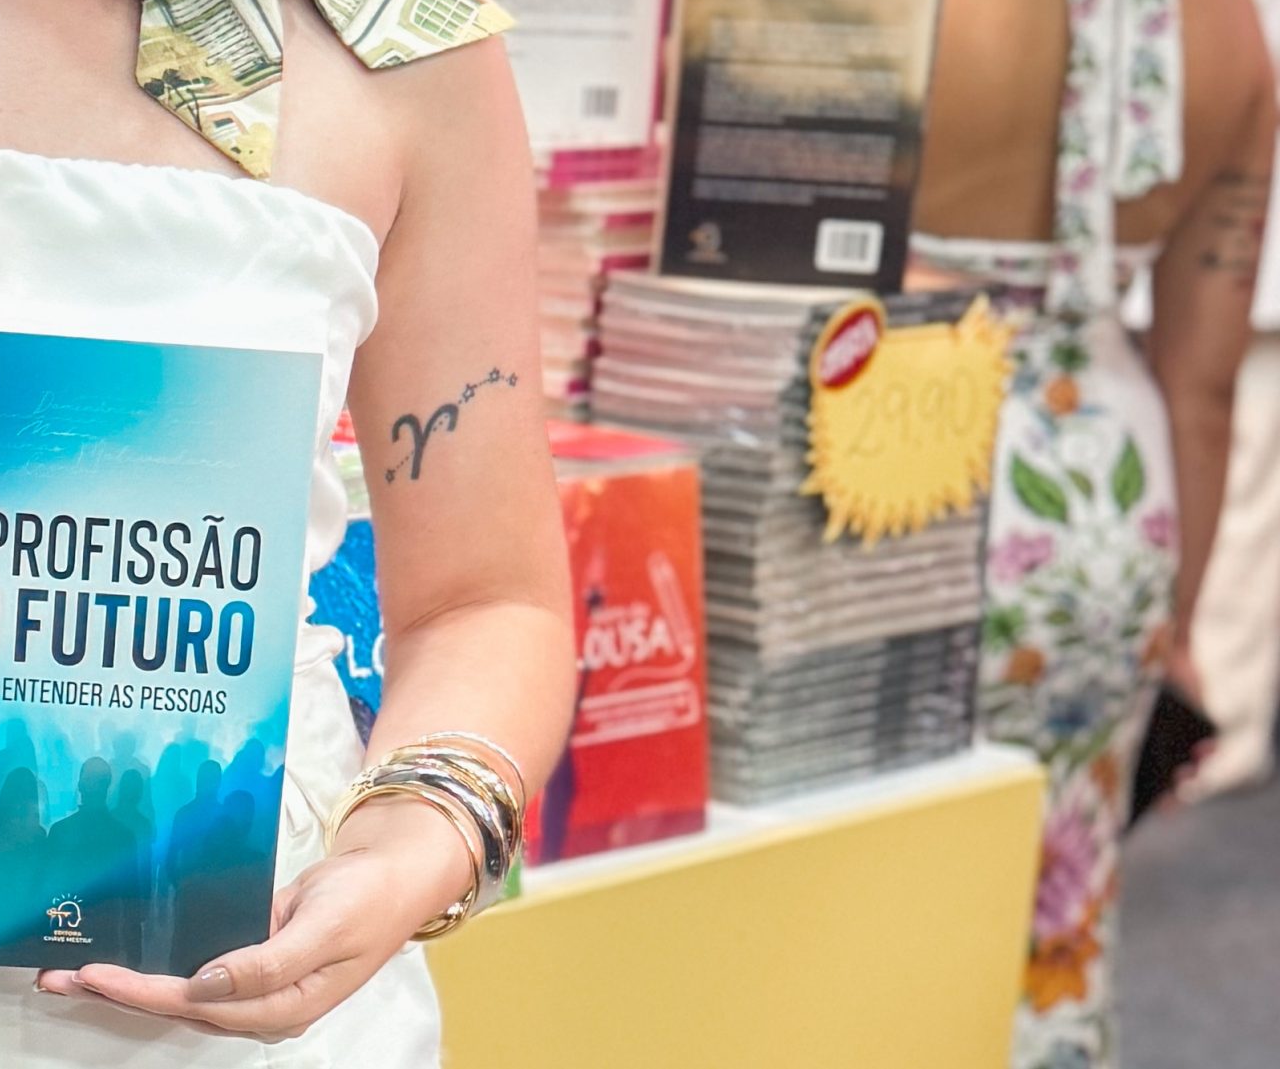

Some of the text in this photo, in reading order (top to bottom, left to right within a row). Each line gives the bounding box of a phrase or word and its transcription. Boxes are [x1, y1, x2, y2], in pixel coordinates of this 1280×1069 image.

[14, 587, 256, 677] FUTURO
[577, 617, 676, 670] OUSA
[2, 677, 103, 707] ENTENDER
[108, 684, 134, 709] AS
[140, 686, 228, 715] PESSOAS
